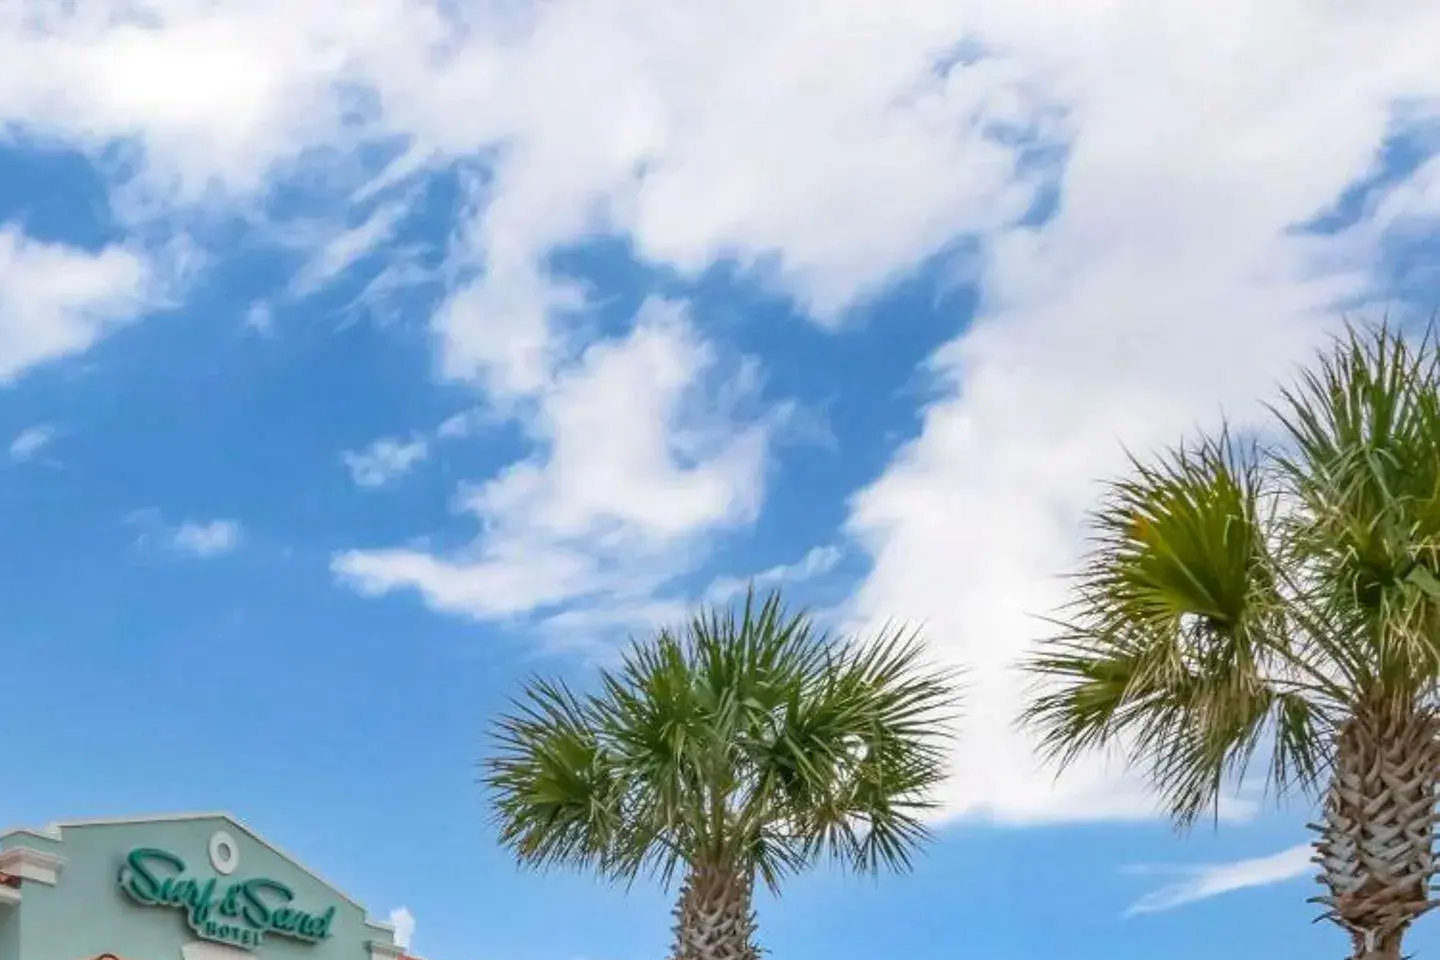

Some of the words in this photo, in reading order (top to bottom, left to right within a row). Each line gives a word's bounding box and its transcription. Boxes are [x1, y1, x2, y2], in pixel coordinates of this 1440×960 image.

[127, 847, 217, 925] Surf
[242, 877, 335, 938] Sand
[206, 921, 263, 946] HOTEL
